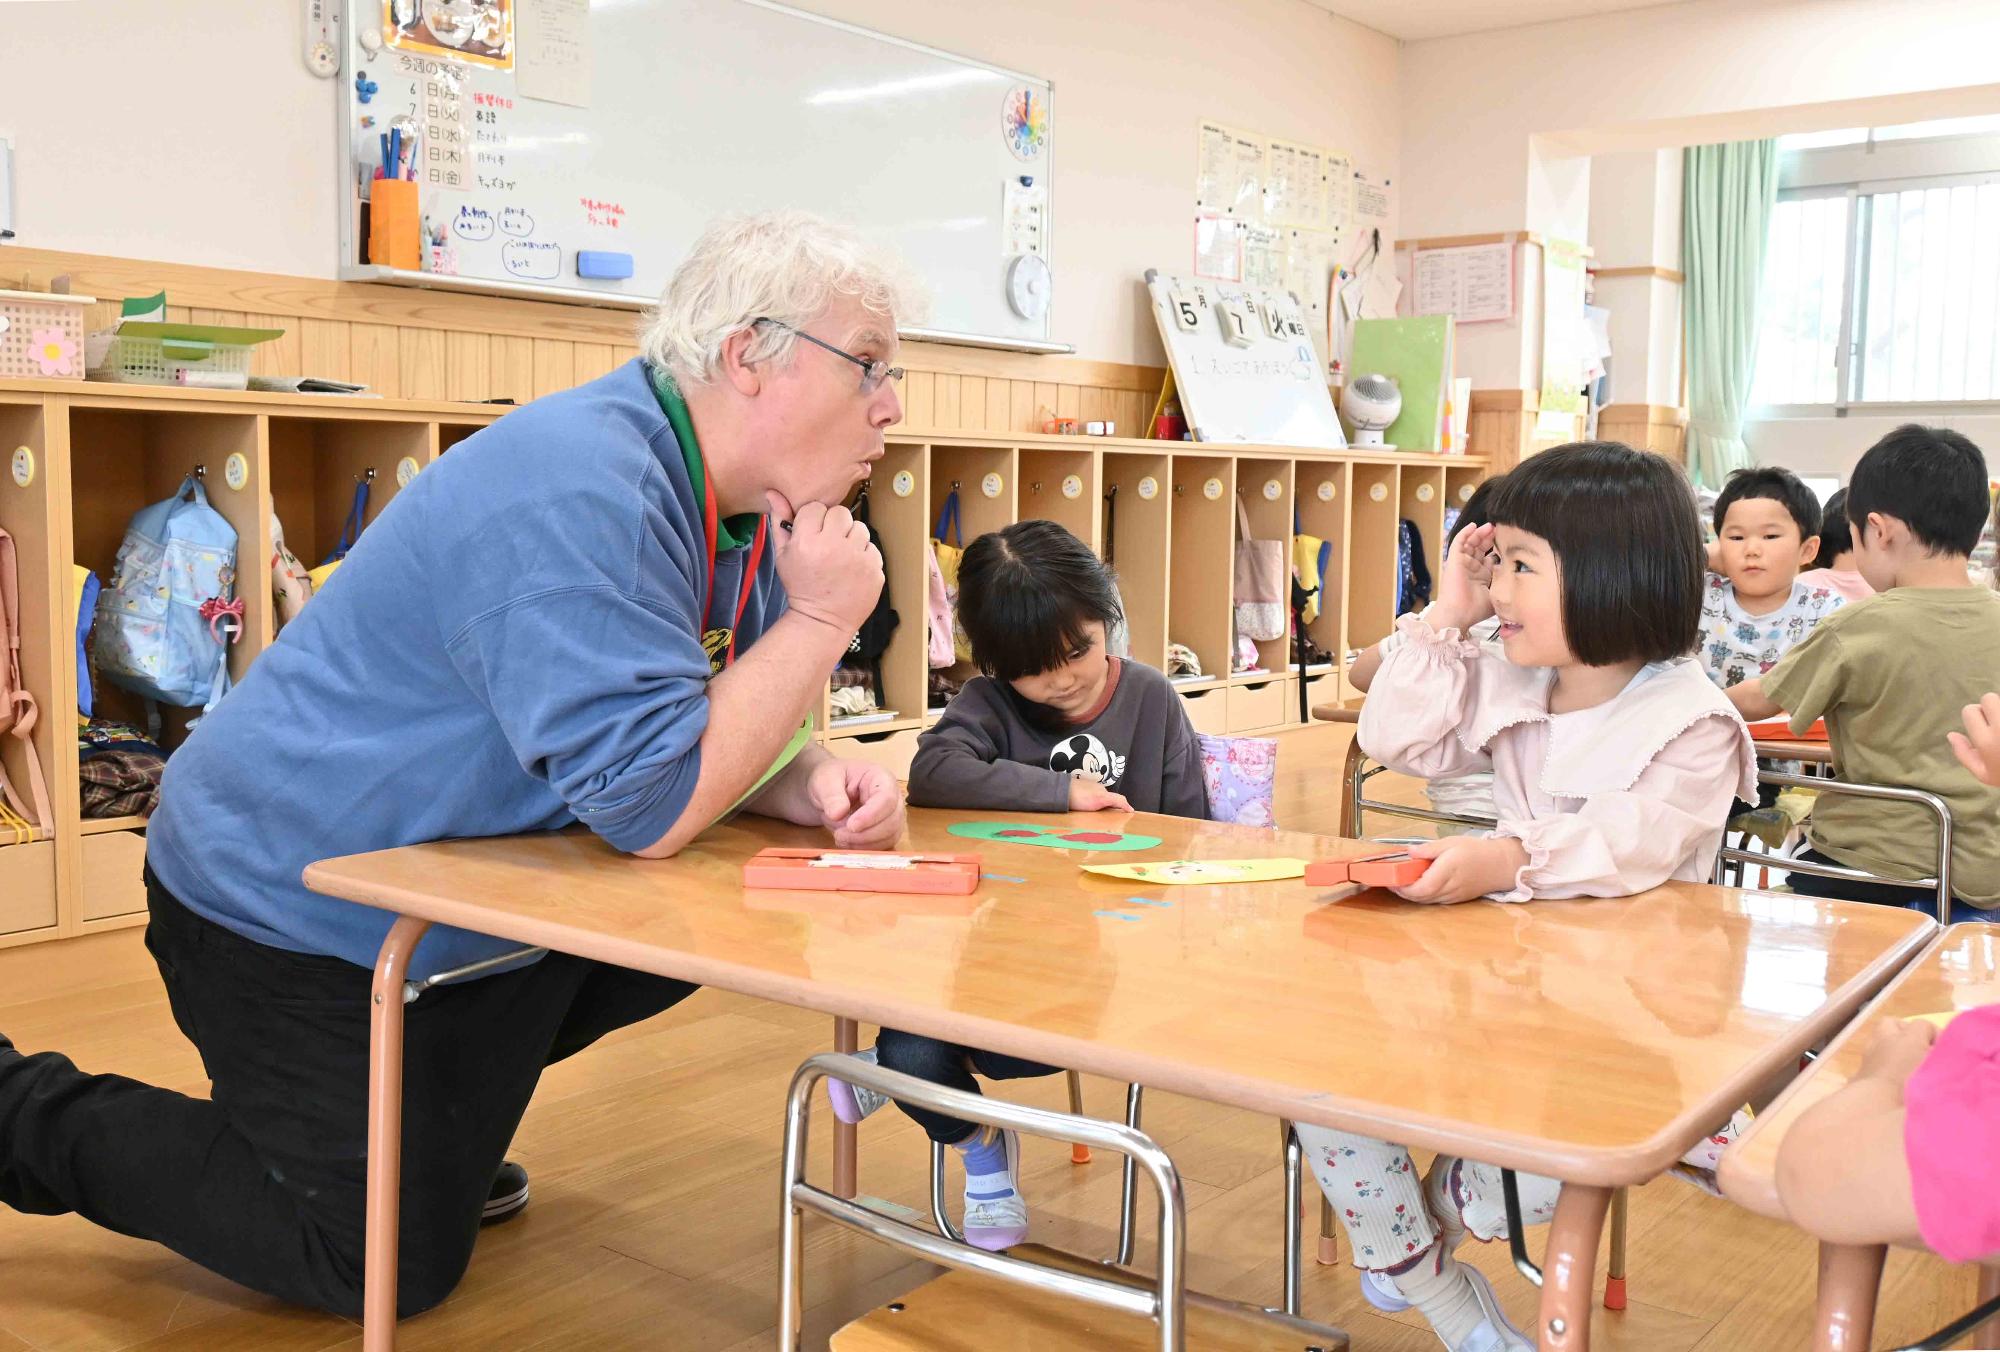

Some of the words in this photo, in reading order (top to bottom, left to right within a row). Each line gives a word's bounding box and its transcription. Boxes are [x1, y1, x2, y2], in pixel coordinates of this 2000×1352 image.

[400, 55, 464, 81] 今週の予定
[410, 82, 416, 95] 6
[409, 102, 416, 116] 7
[429, 125, 461, 143] 日(水)
[429, 147, 461, 164] 日(木)
[429, 168, 461, 185] 日(金)
[1179, 302, 1198, 326] 5
[1231, 311, 1245, 335] 7
[1271, 308, 1288, 338] 火
